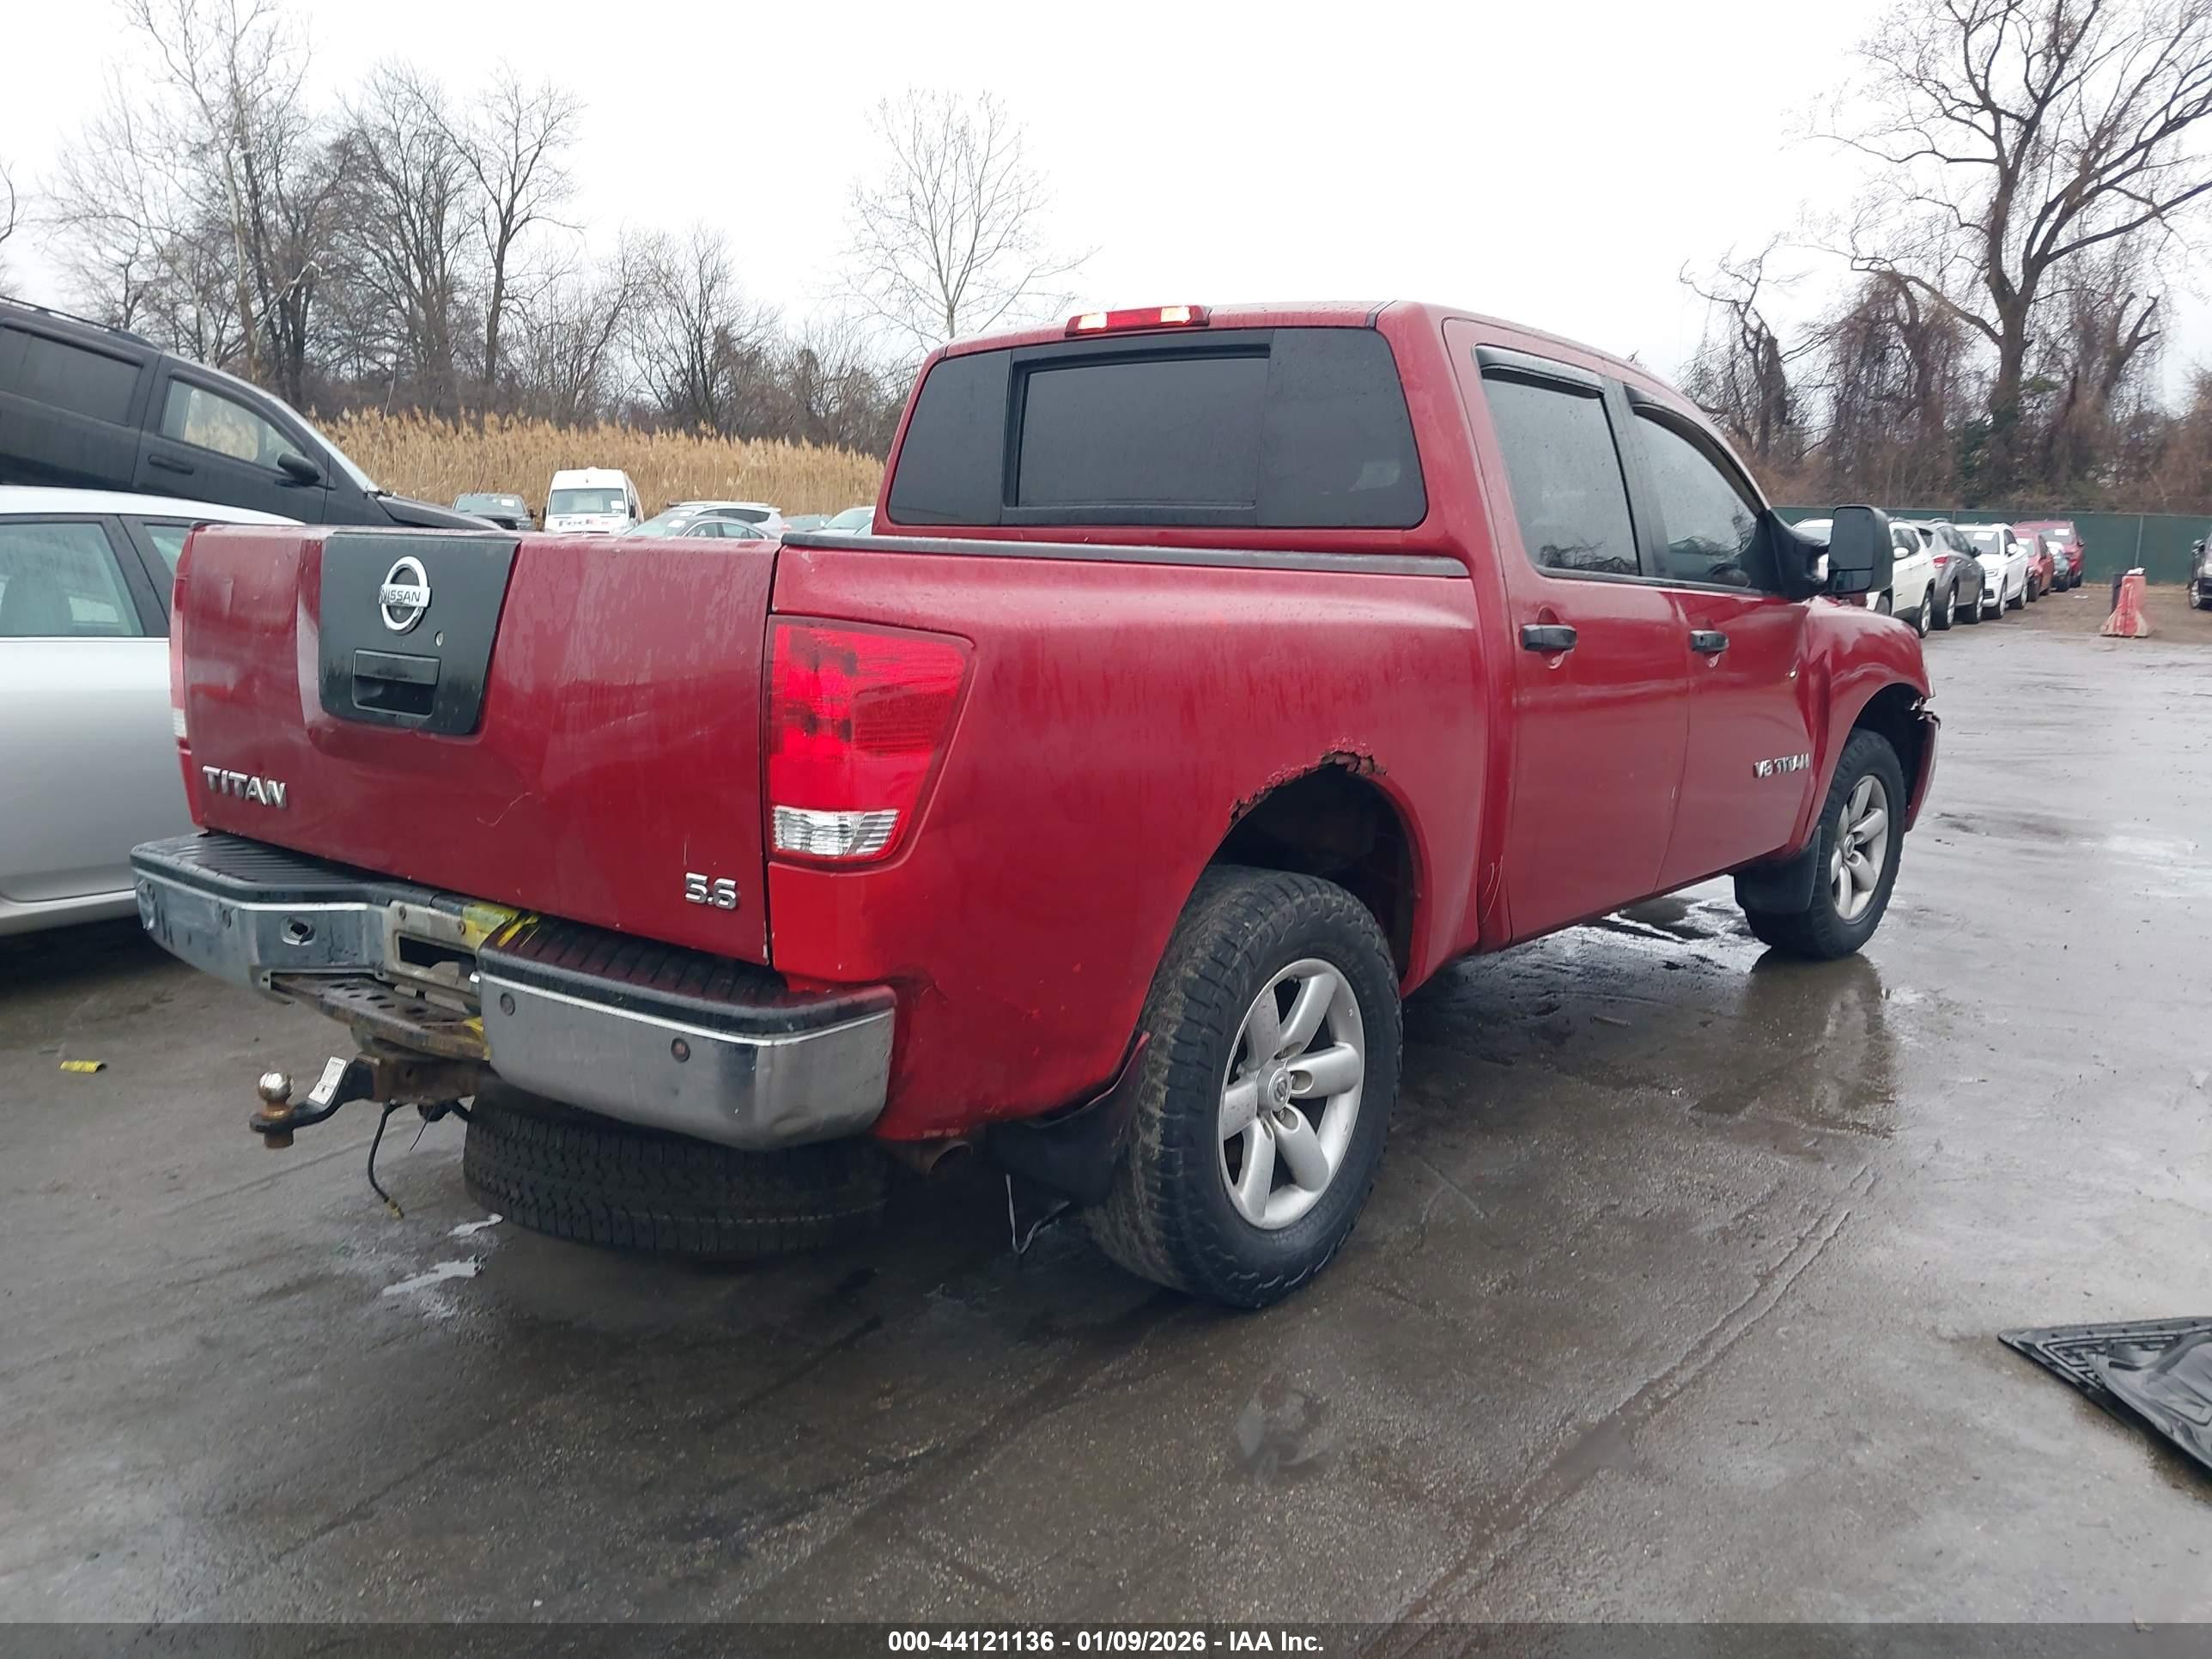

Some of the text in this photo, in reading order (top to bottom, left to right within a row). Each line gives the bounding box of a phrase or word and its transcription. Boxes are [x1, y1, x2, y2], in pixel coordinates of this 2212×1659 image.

[381, 589, 421, 603] NISSAN
[1753, 759, 1773, 778] V8
[202, 765, 287, 810] TITAN
[685, 872, 737, 910] 5.6
